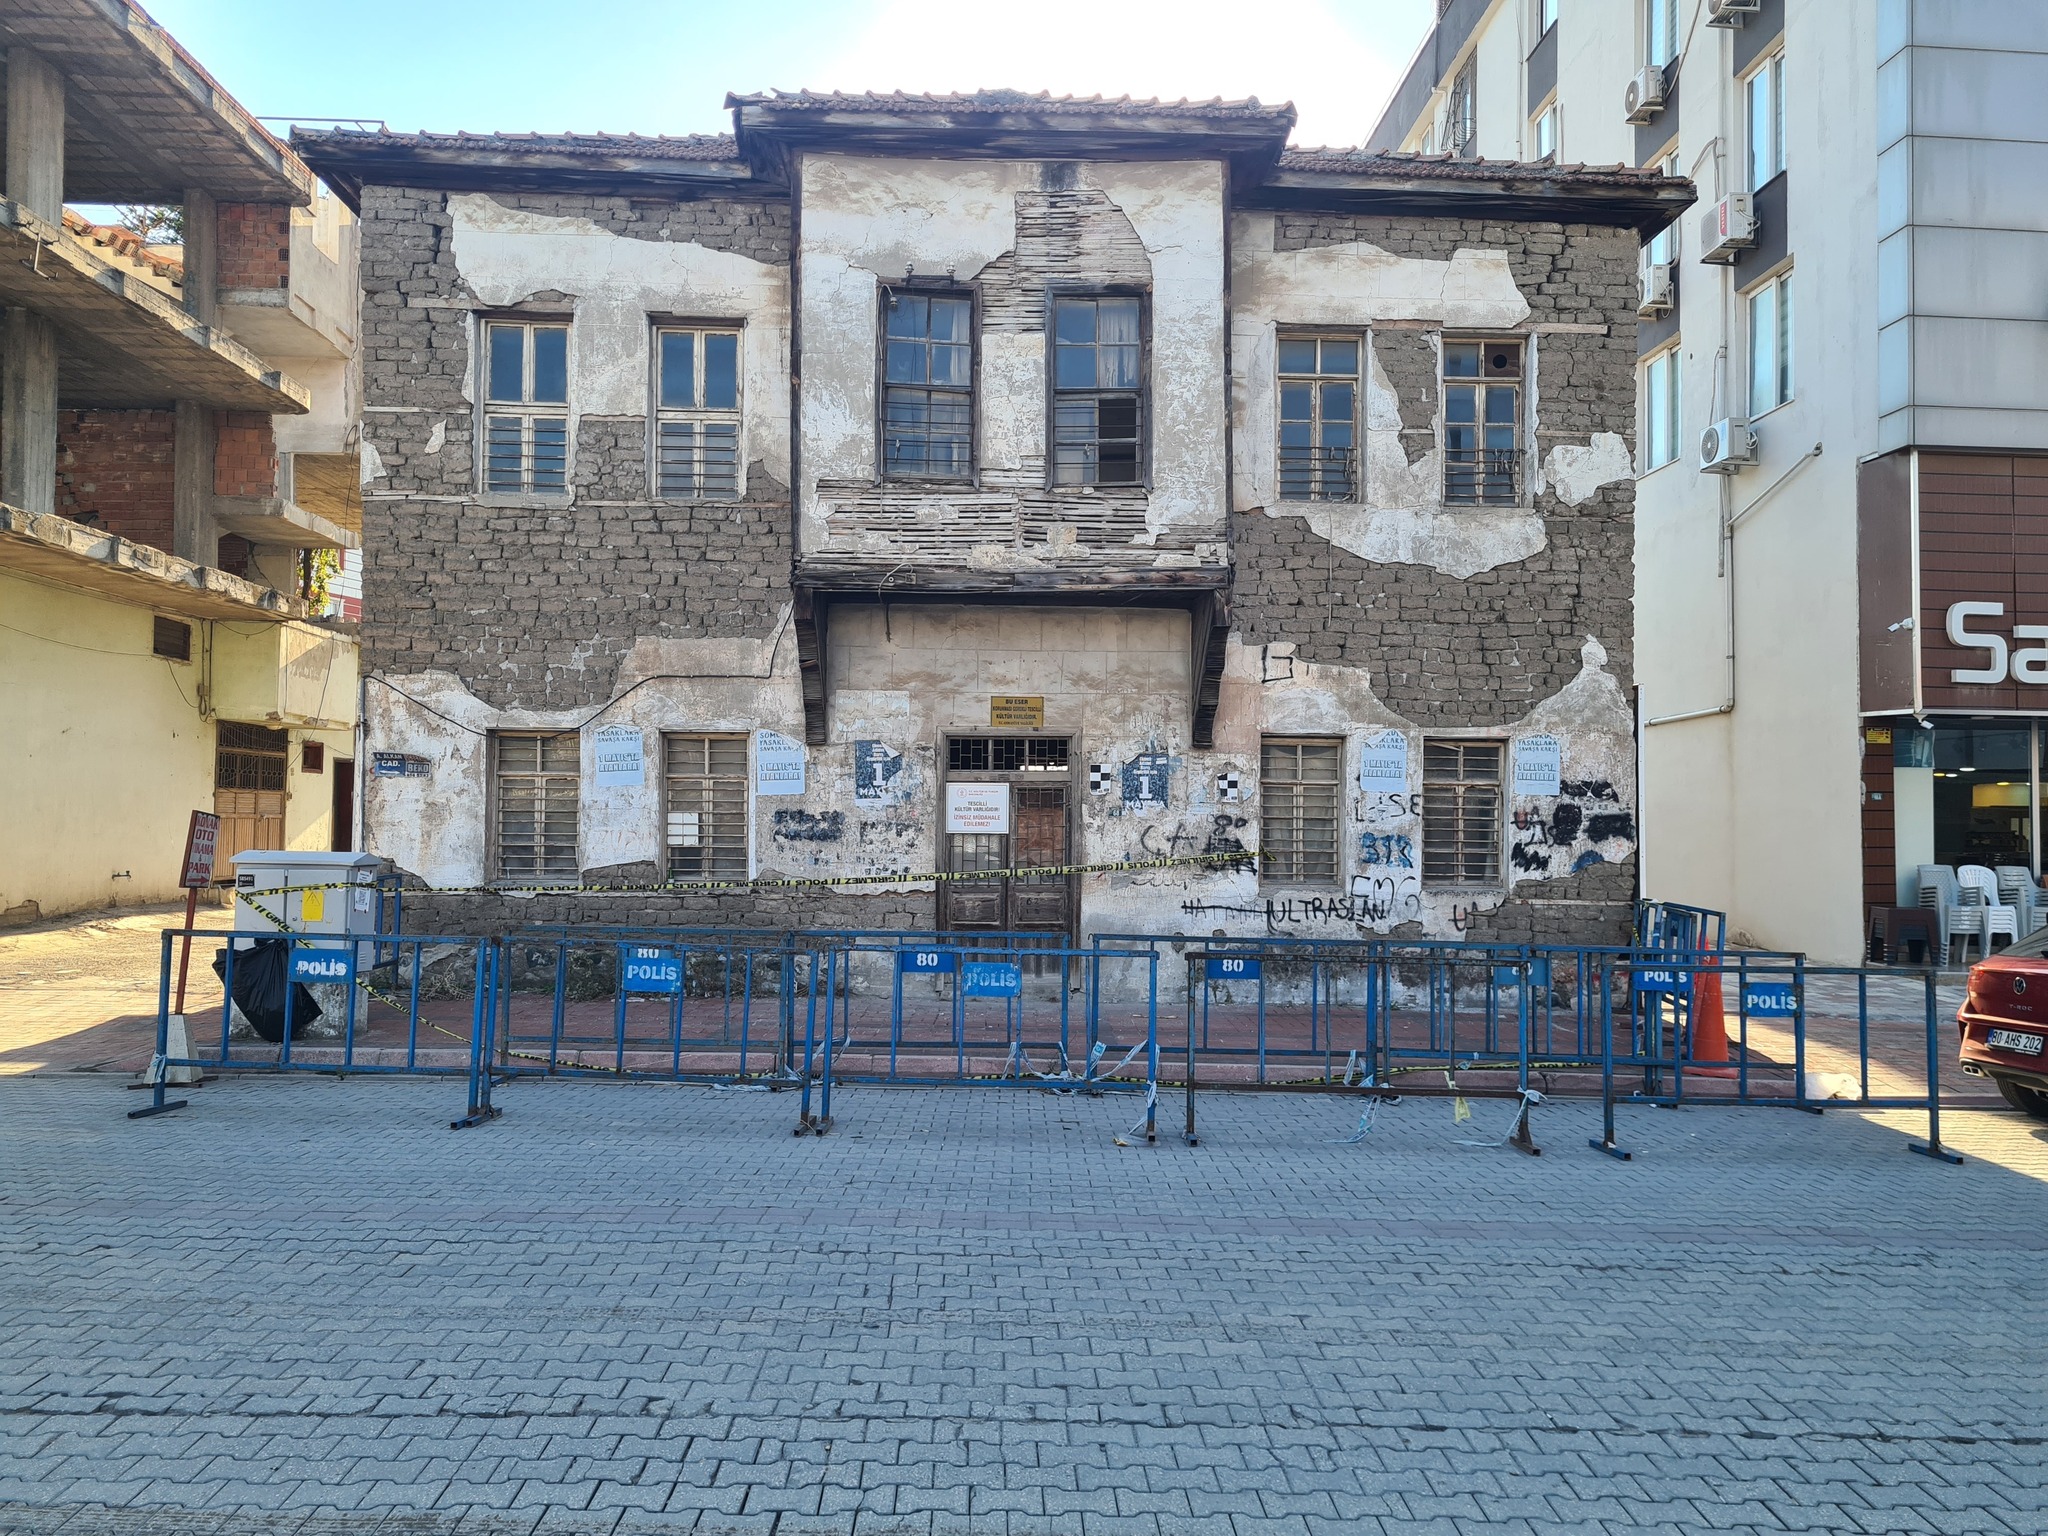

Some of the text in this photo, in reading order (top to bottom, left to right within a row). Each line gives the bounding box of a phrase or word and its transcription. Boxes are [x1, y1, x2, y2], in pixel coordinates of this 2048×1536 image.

[408, 764, 429, 772] BEKO
[872, 763, 886, 786] 1
[1139, 776, 1152, 798] 1
[196, 829, 214, 842] OTO
[188, 862, 211, 874] PARK
[916, 952, 938, 966] 80
[1222, 959, 1244, 972] 80
[627, 962, 677, 980] POLİS
[1644, 971, 1688, 983] POLS
[1747, 991, 1798, 1010] POLİS
[1992, 1031, 2042, 1050] 80 AHS 202
